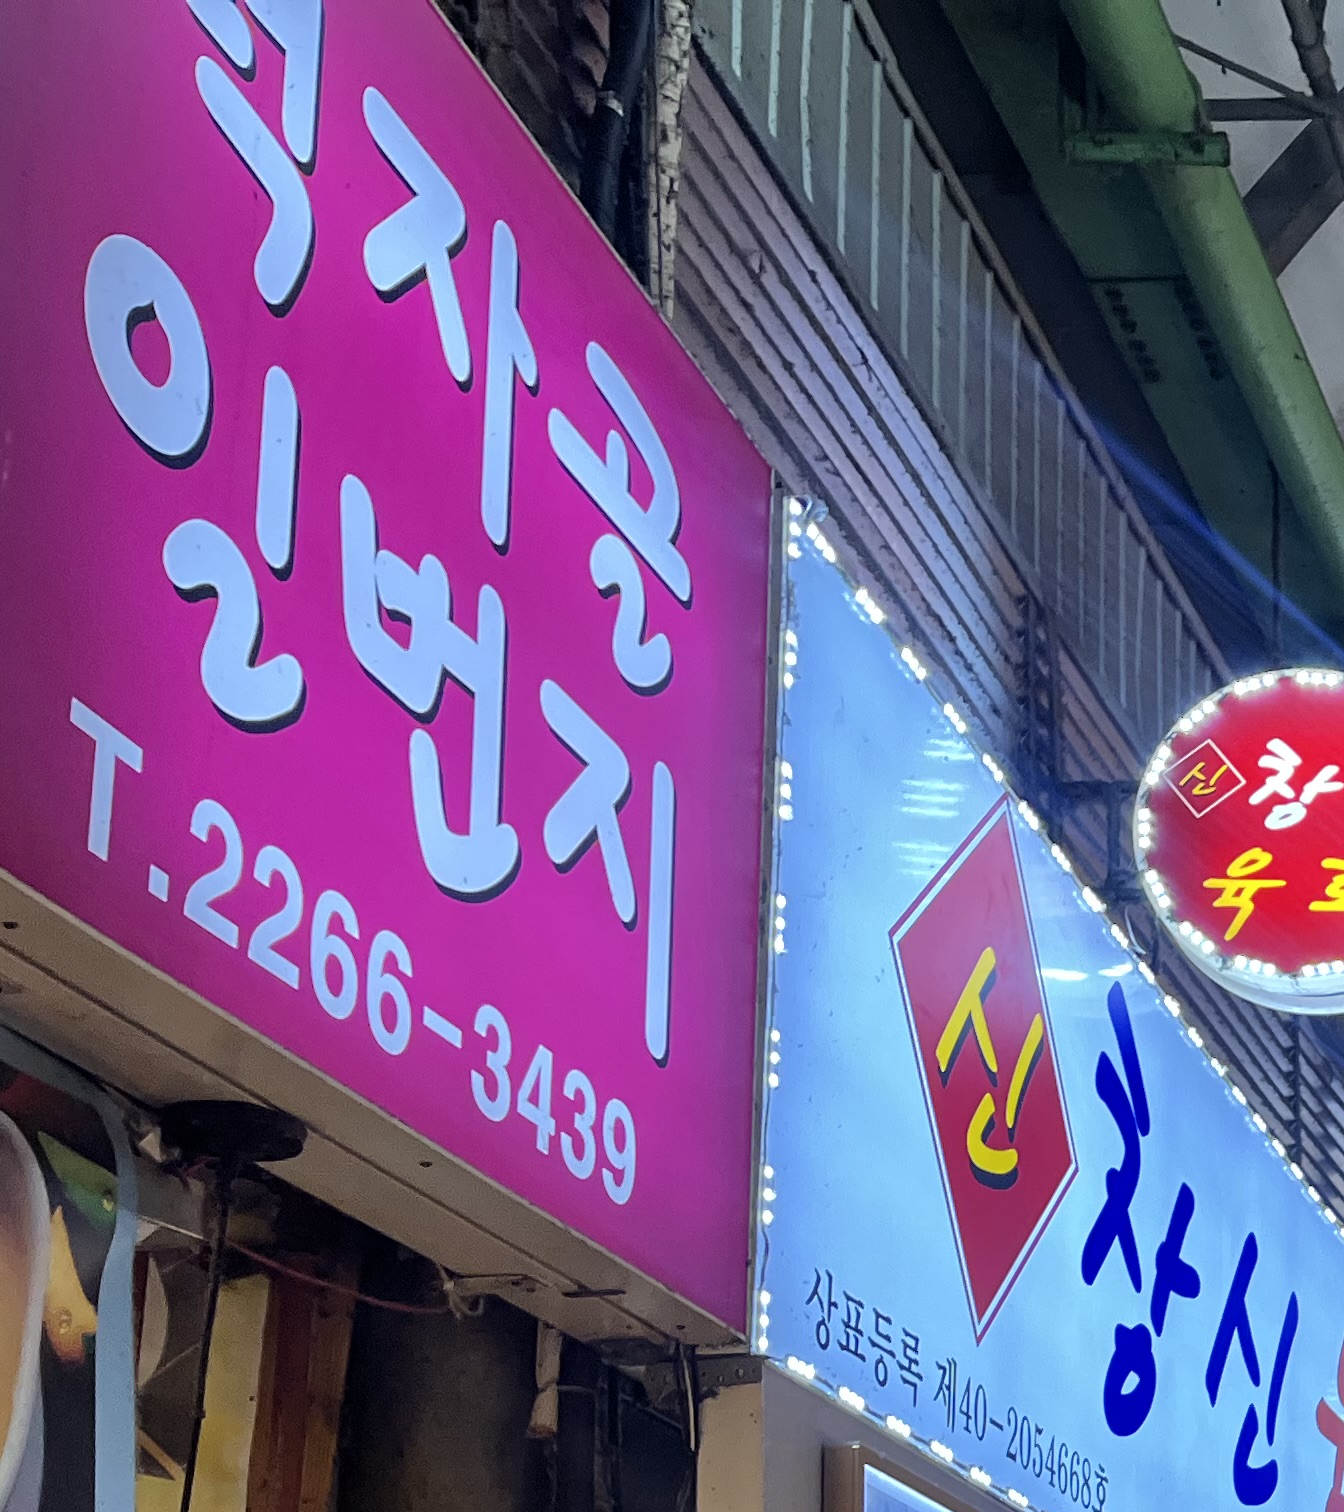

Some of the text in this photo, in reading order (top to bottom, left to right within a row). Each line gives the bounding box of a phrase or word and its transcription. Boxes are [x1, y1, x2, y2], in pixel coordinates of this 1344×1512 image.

[83, 233, 676, 1062] 일번지
[1180, 762, 1227, 797] 신
[70, 697, 637, 1205] T.2266-3439
[936, 947, 1044, 1189] 신
[805, 1266, 923, 1408] 상표등록
[1082, 980, 1299, 1507] 창신
